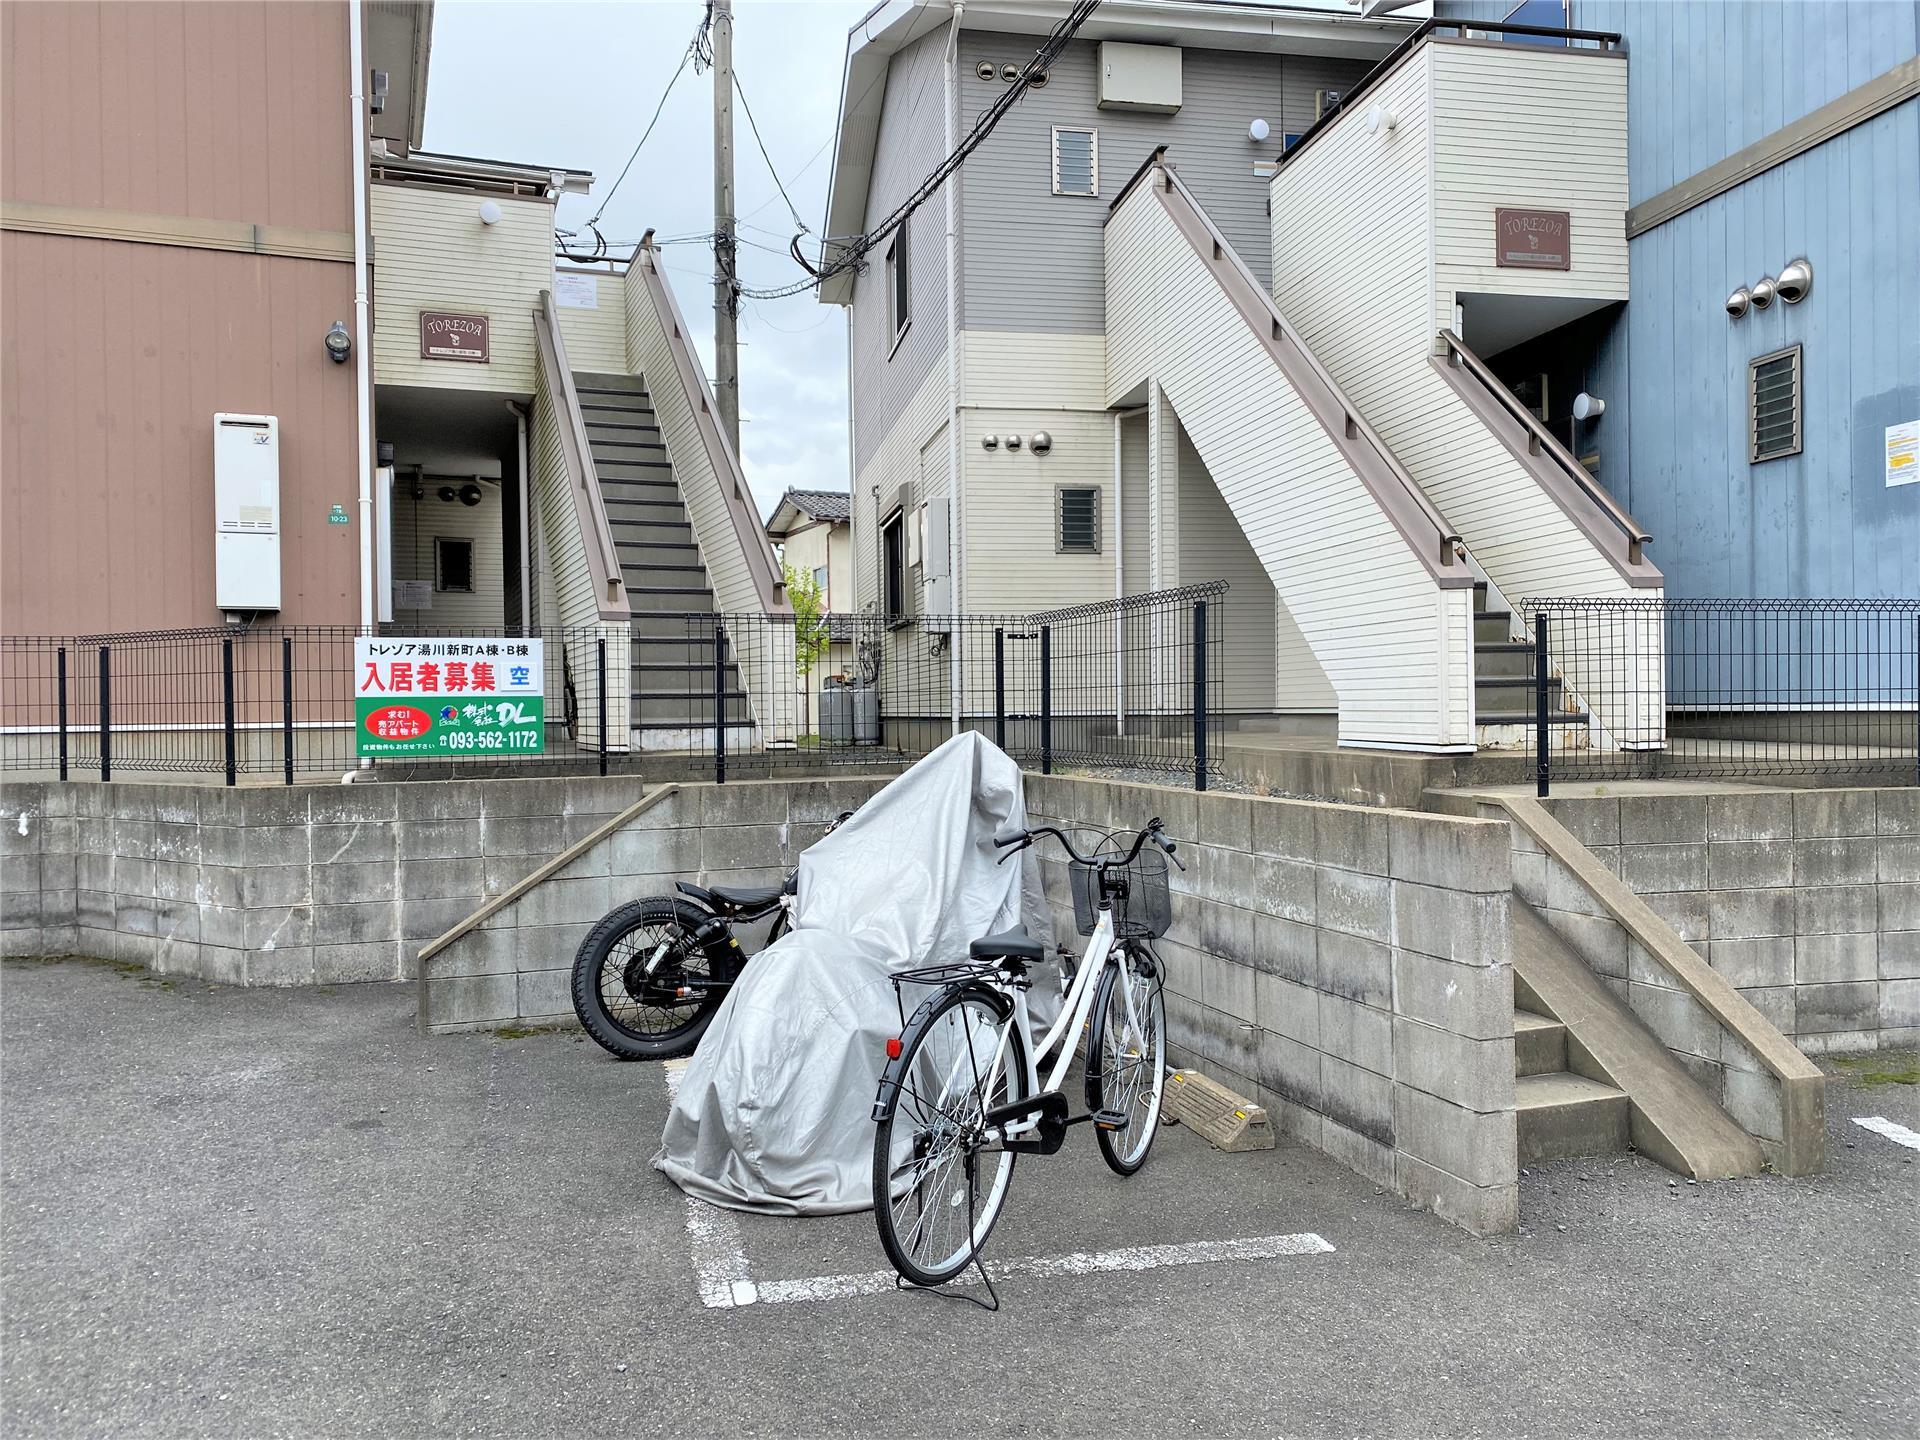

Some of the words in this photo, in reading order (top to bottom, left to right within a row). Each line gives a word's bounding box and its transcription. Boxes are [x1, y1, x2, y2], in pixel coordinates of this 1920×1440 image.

[1505, 217, 1562, 236] TOREZOA
[428, 318, 482, 336] TOREZOA
[361, 662, 496, 692] 入居者募集
[510, 666, 530, 685] 空
[496, 702, 537, 728] DL
[449, 731, 538, 749] 093-562-1172
